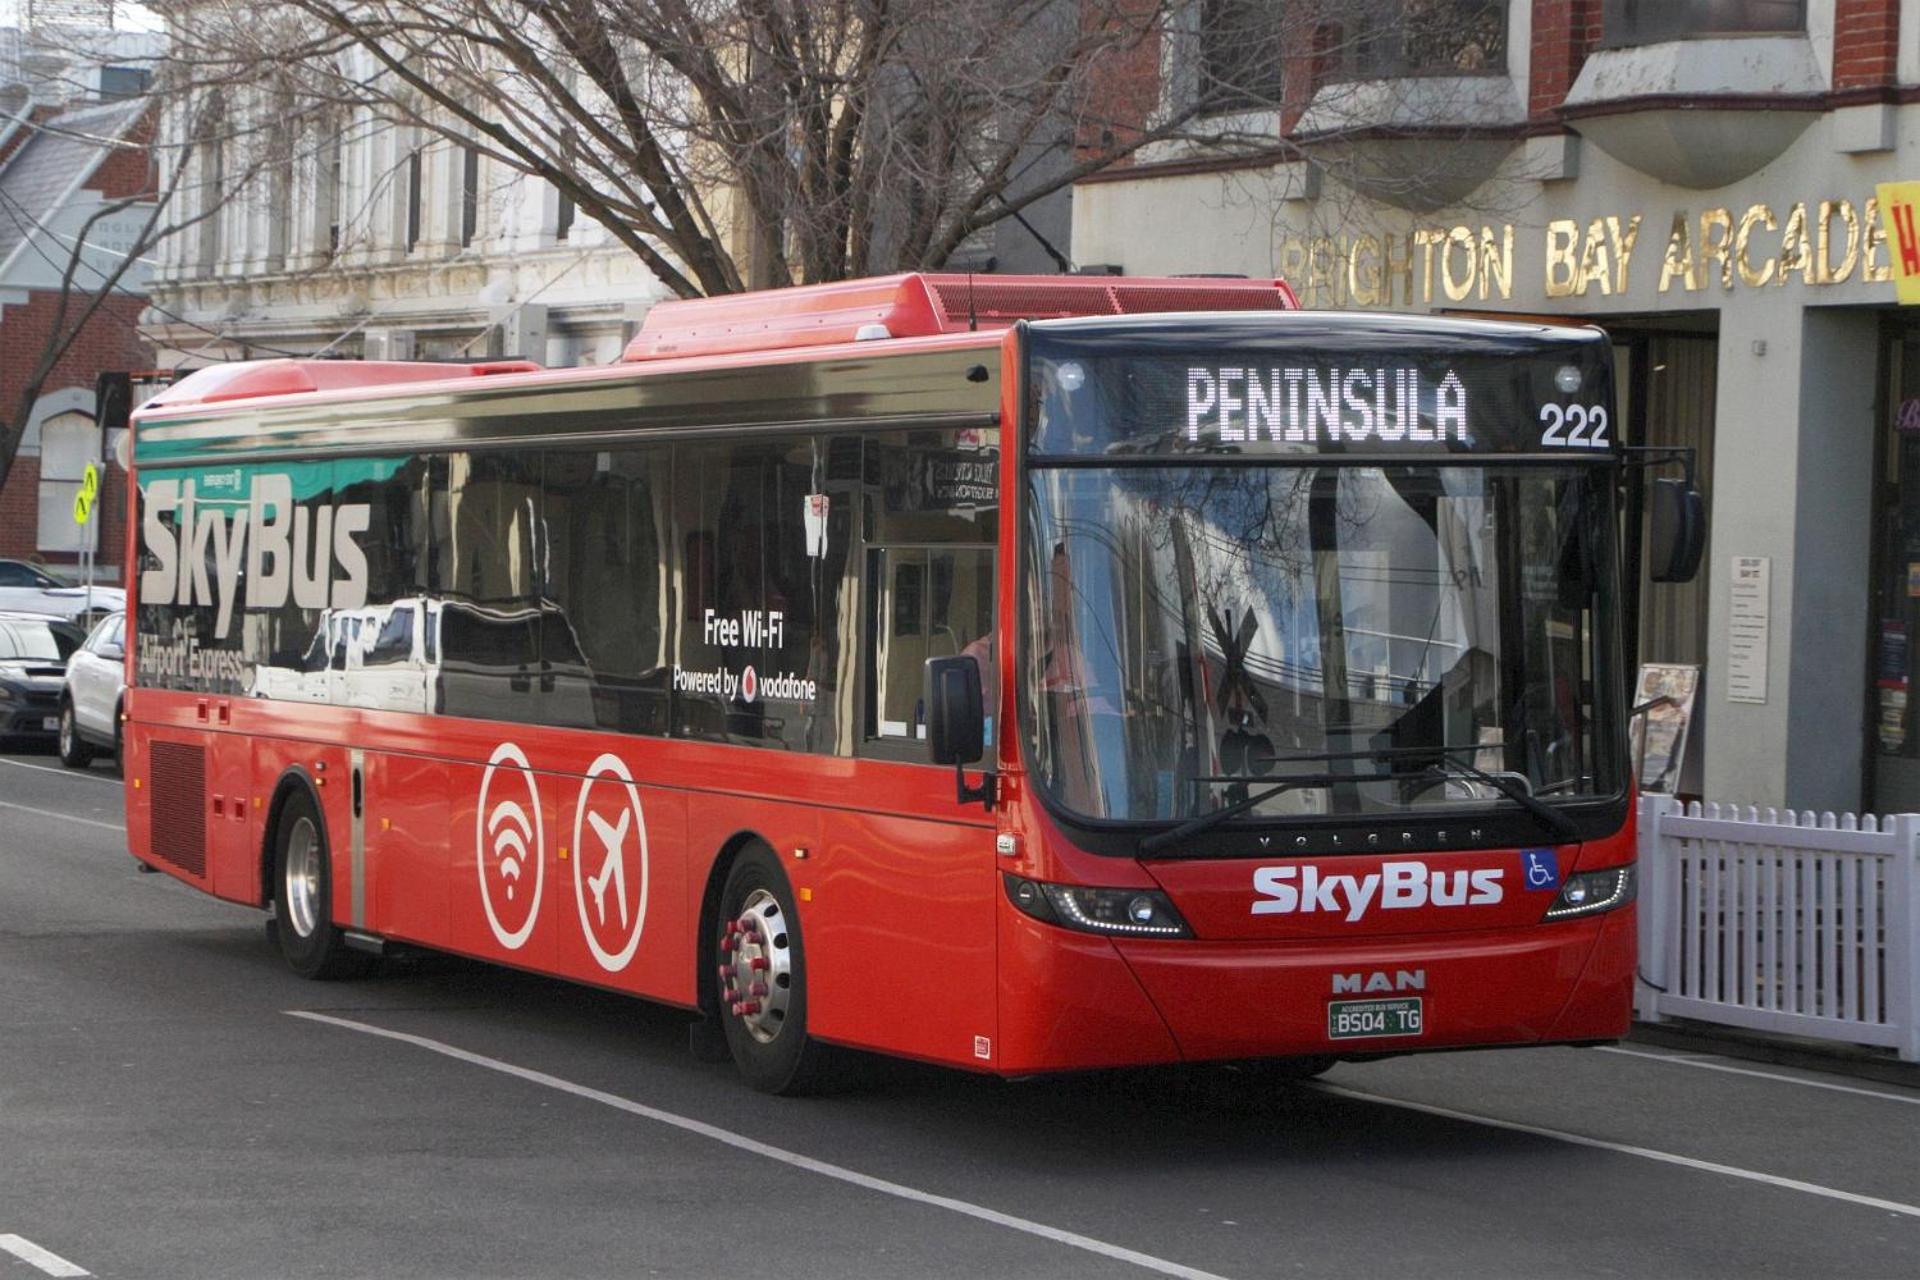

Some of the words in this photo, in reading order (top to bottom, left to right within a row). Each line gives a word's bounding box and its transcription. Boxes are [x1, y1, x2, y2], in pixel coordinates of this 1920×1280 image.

[1545, 214, 1645, 298] BAY
[1658, 198, 1896, 292] ARCADE
[1187, 367, 1467, 441] PENINSULA
[1539, 403, 1610, 448] 222
[140, 473, 371, 639] SkyBus
[704, 608, 739, 647] Free
[742, 609, 784, 649] Wi-Fi
[189, 638, 245, 688] Express
[673, 664, 722, 694] Powered
[724, 667, 739, 702] by
[760, 671, 816, 700] vodafone
[1258, 829, 1482, 848] VOLGREN
[1251, 861, 1504, 922] SkyBus
[1332, 969, 1425, 994] MAN
[1338, 1011, 1385, 1033] BS04
[1396, 1009, 1420, 1030] TG
